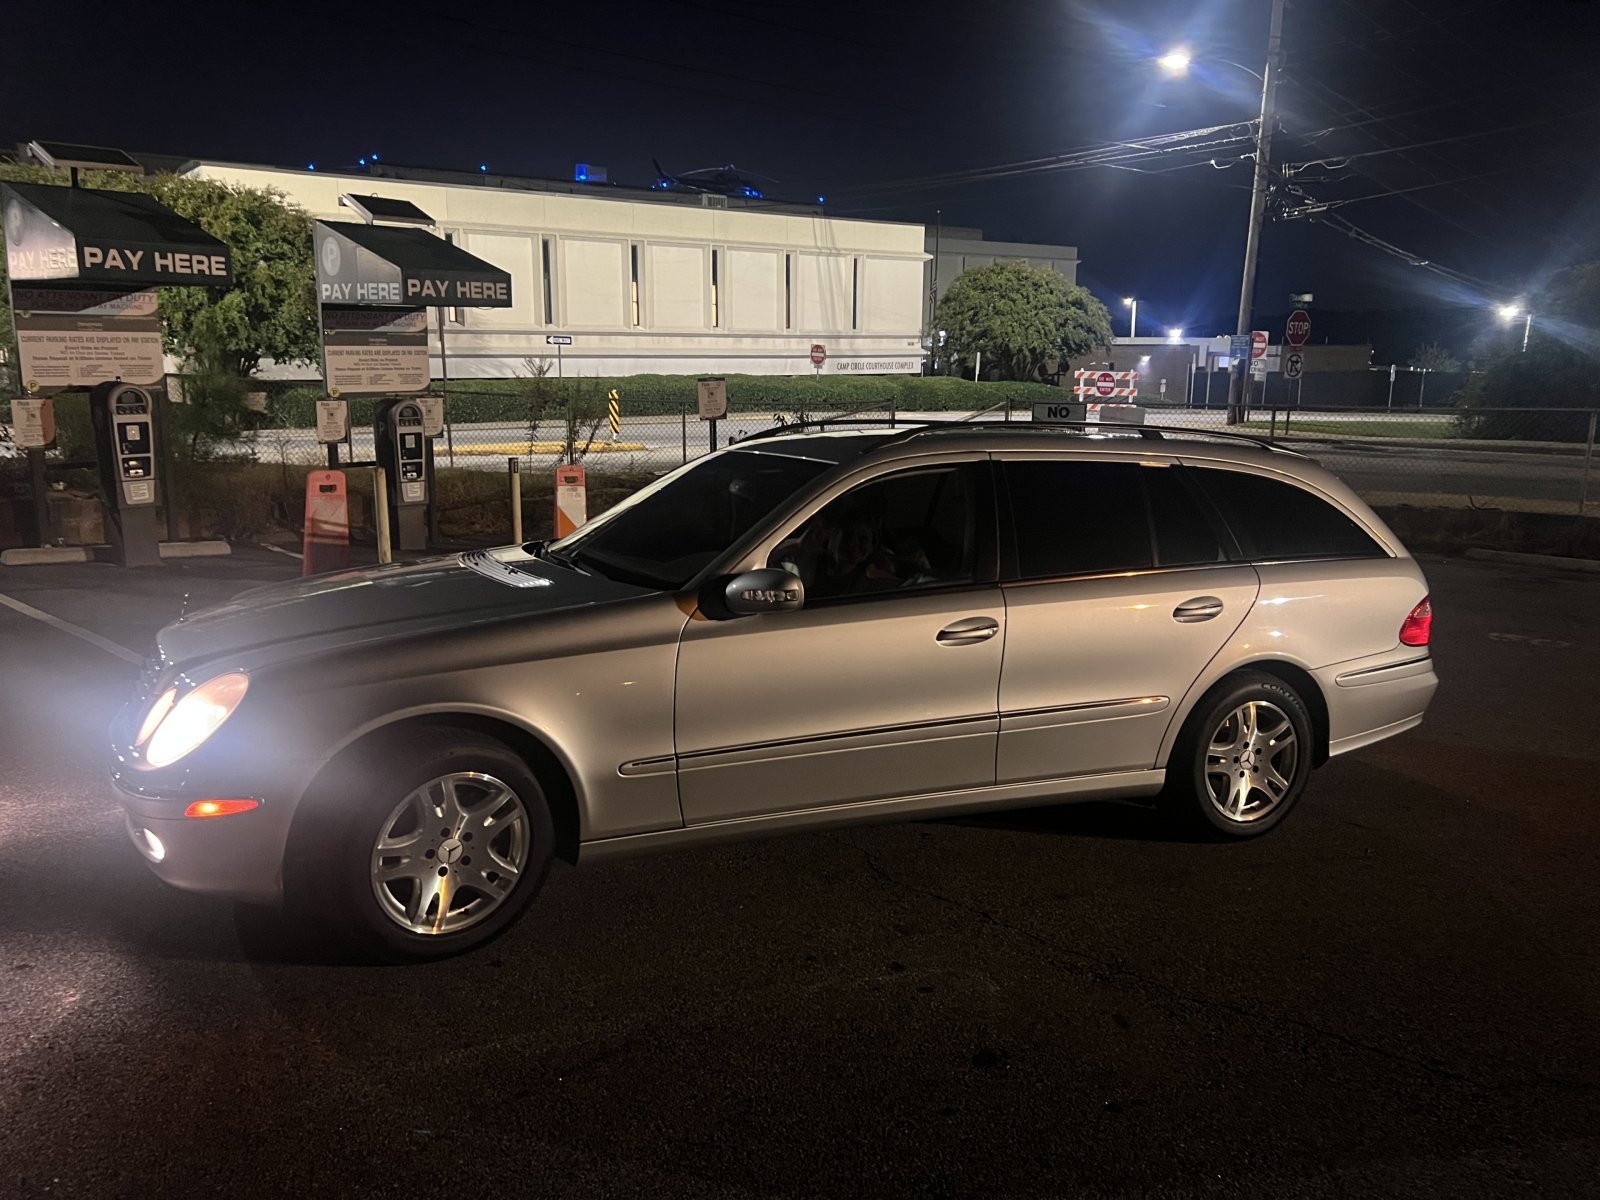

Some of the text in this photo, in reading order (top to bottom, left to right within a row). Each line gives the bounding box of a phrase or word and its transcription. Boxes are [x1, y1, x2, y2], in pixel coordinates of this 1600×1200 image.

[9, 248, 77, 269] PAY HERE
[84, 246, 228, 276] PAY HERE
[322, 282, 400, 300] PAY HERE
[407, 279, 508, 300] PAY HERE
[126, 294, 155, 303] DUTY
[1288, 322, 1309, 335] STOP
[894, 362, 914, 370] COMPLEX
[1047, 406, 1070, 419] NO
